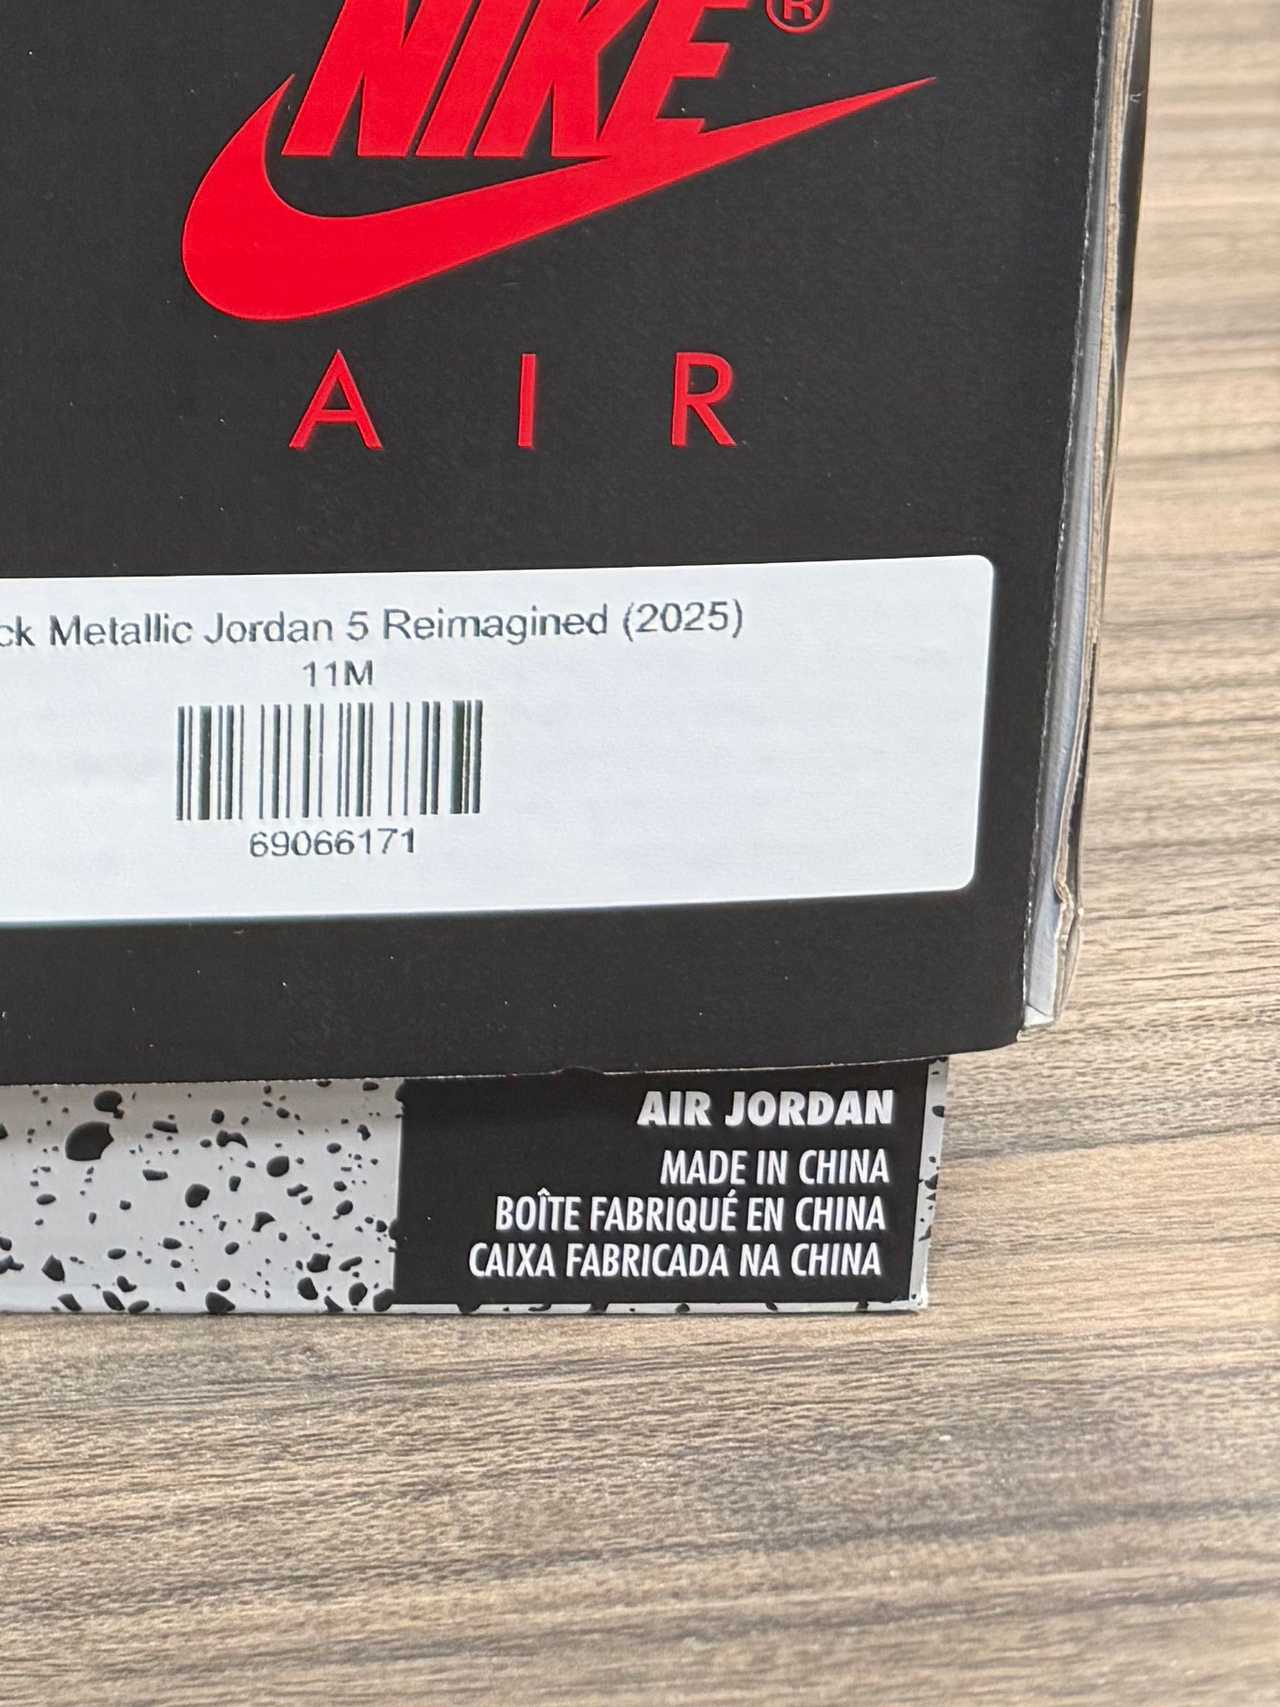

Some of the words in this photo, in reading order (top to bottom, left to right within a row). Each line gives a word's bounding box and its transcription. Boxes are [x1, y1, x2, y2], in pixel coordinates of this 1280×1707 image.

[49, 612, 194, 647] Metallic
[203, 609, 334, 646] Jordan
[346, 609, 370, 643] 5
[383, 603, 609, 647] Reimagined
[622, 598, 744, 643] (2025)
[302, 659, 374, 689] 11M
[248, 827, 416, 859] 69066171
[636, 1090, 712, 1127] AIR
[724, 1089, 894, 1126] JORDAN
[659, 1148, 748, 1185] MADE
[756, 1149, 789, 1185] IN
[798, 1147, 891, 1185] CHINA
[495, 1187, 582, 1233] BOÎTE
[590, 1188, 739, 1234] FABRIQUÉ
[746, 1196, 785, 1233] EN
[795, 1195, 887, 1233] CHINA
[468, 1242, 556, 1278] CAIXA
[566, 1242, 731, 1278] FABRICADA
[739, 1242, 781, 1278] NA
[791, 1241, 882, 1278] CHINA
